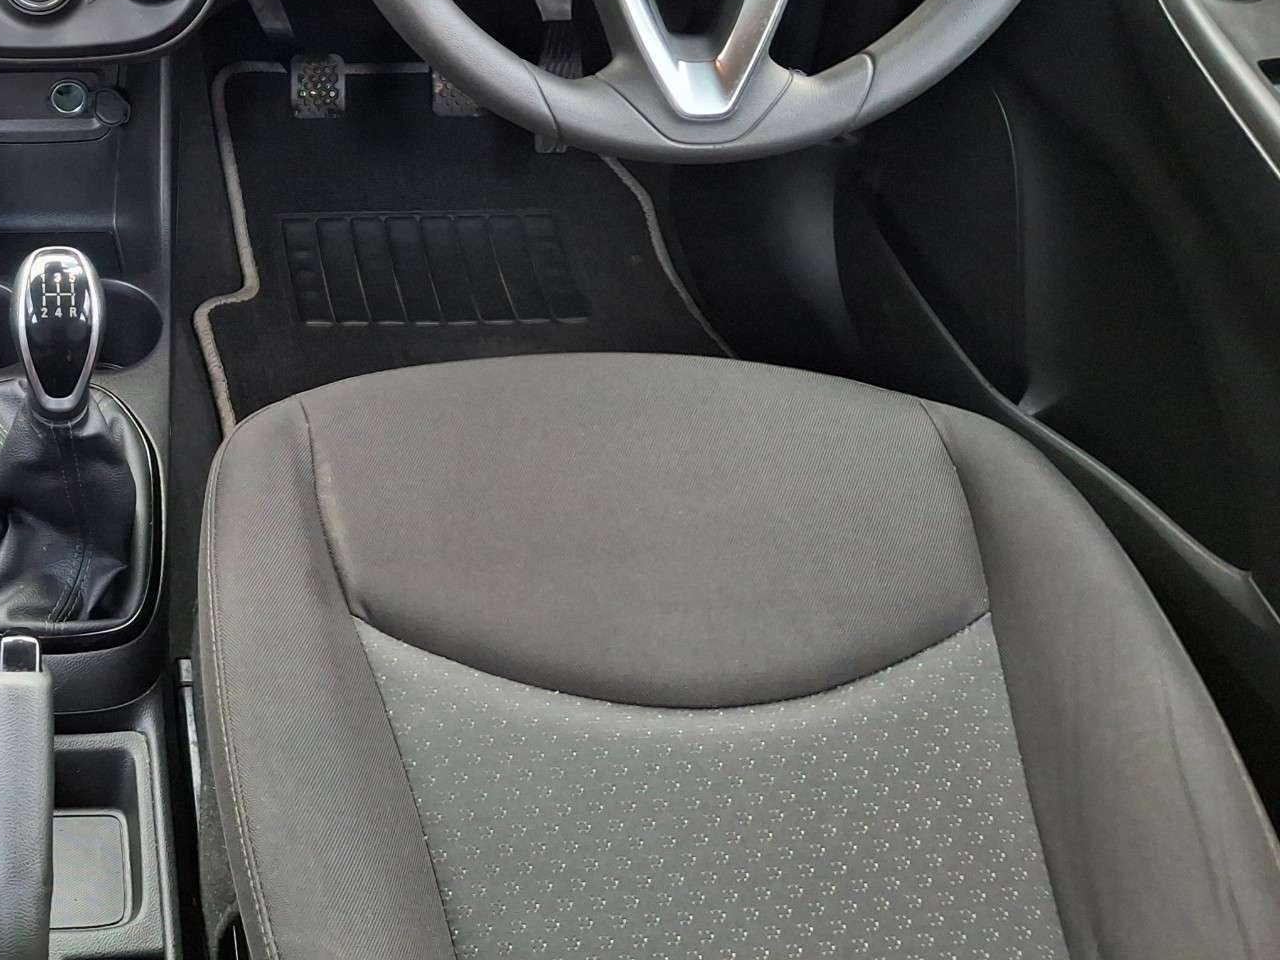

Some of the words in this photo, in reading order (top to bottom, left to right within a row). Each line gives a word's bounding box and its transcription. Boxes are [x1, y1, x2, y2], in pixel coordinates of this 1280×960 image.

[54, 272, 61, 283] 3
[69, 272, 76, 283] 5
[41, 307, 48, 318] 2
[55, 307, 63, 318] 4
[70, 307, 77, 318] R
